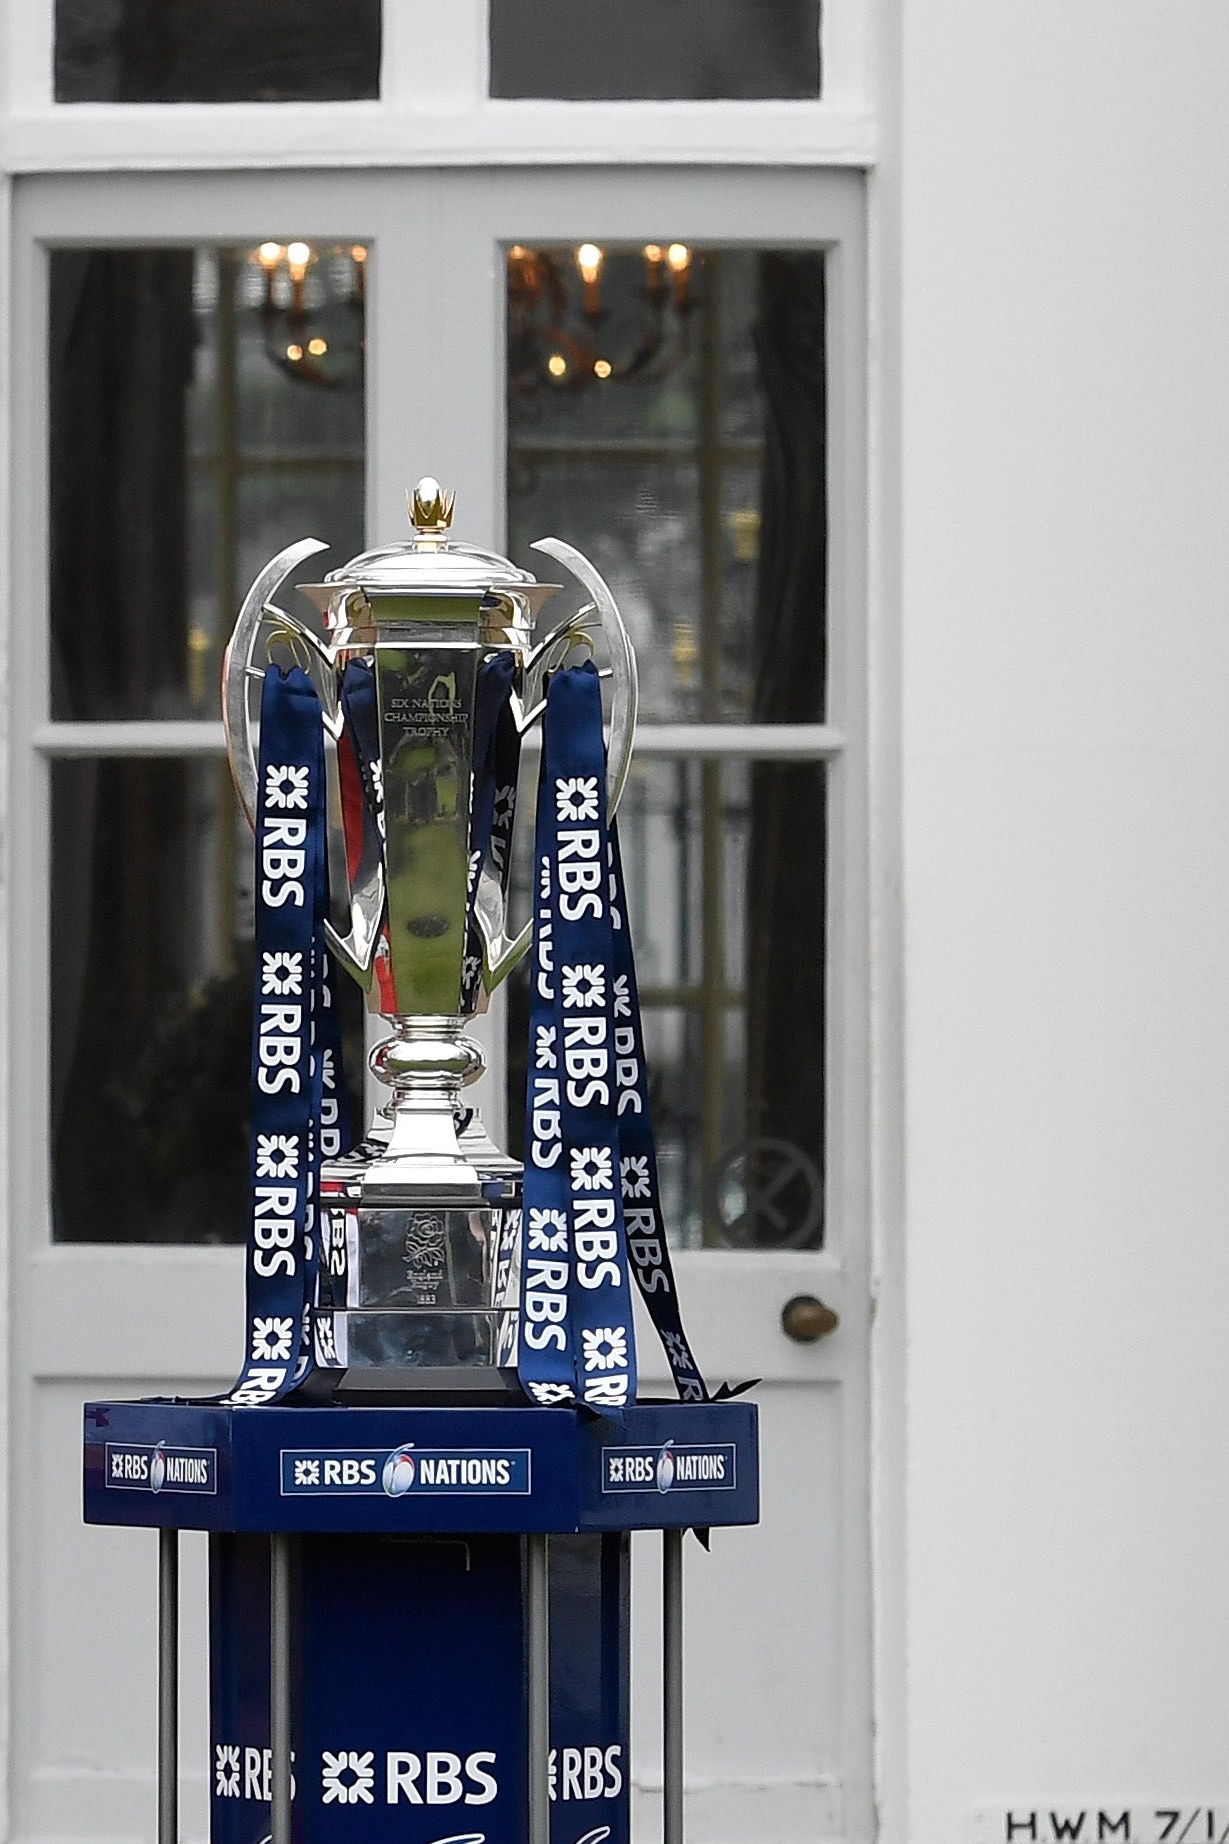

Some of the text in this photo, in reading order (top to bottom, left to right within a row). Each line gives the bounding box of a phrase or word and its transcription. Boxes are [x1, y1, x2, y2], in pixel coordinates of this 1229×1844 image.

[391, 699, 410, 708] SIX
[403, 727, 450, 736] TROPHY
[262, 818, 306, 907] RBS
[558, 830, 602, 920] RBS
[258, 1005, 301, 1093] RBS
[564, 1017, 609, 1107] RBS
[254, 1187, 297, 1276] RBS
[573, 1199, 621, 1289] RBS
[622, 1207, 670, 1293] RBS
[525, 1259, 569, 1350] RBS
[231, 1367, 286, 1405] RB
[124, 1455, 207, 1483] RBS NATIONS
[324, 1459, 510, 1485] RBS NATIONS
[625, 1455, 724, 1481] RBS NATIONS
[245, 1747, 296, 1801] RB
[386, 1752, 498, 1805] RBS
[562, 1745, 622, 1801] RBS
